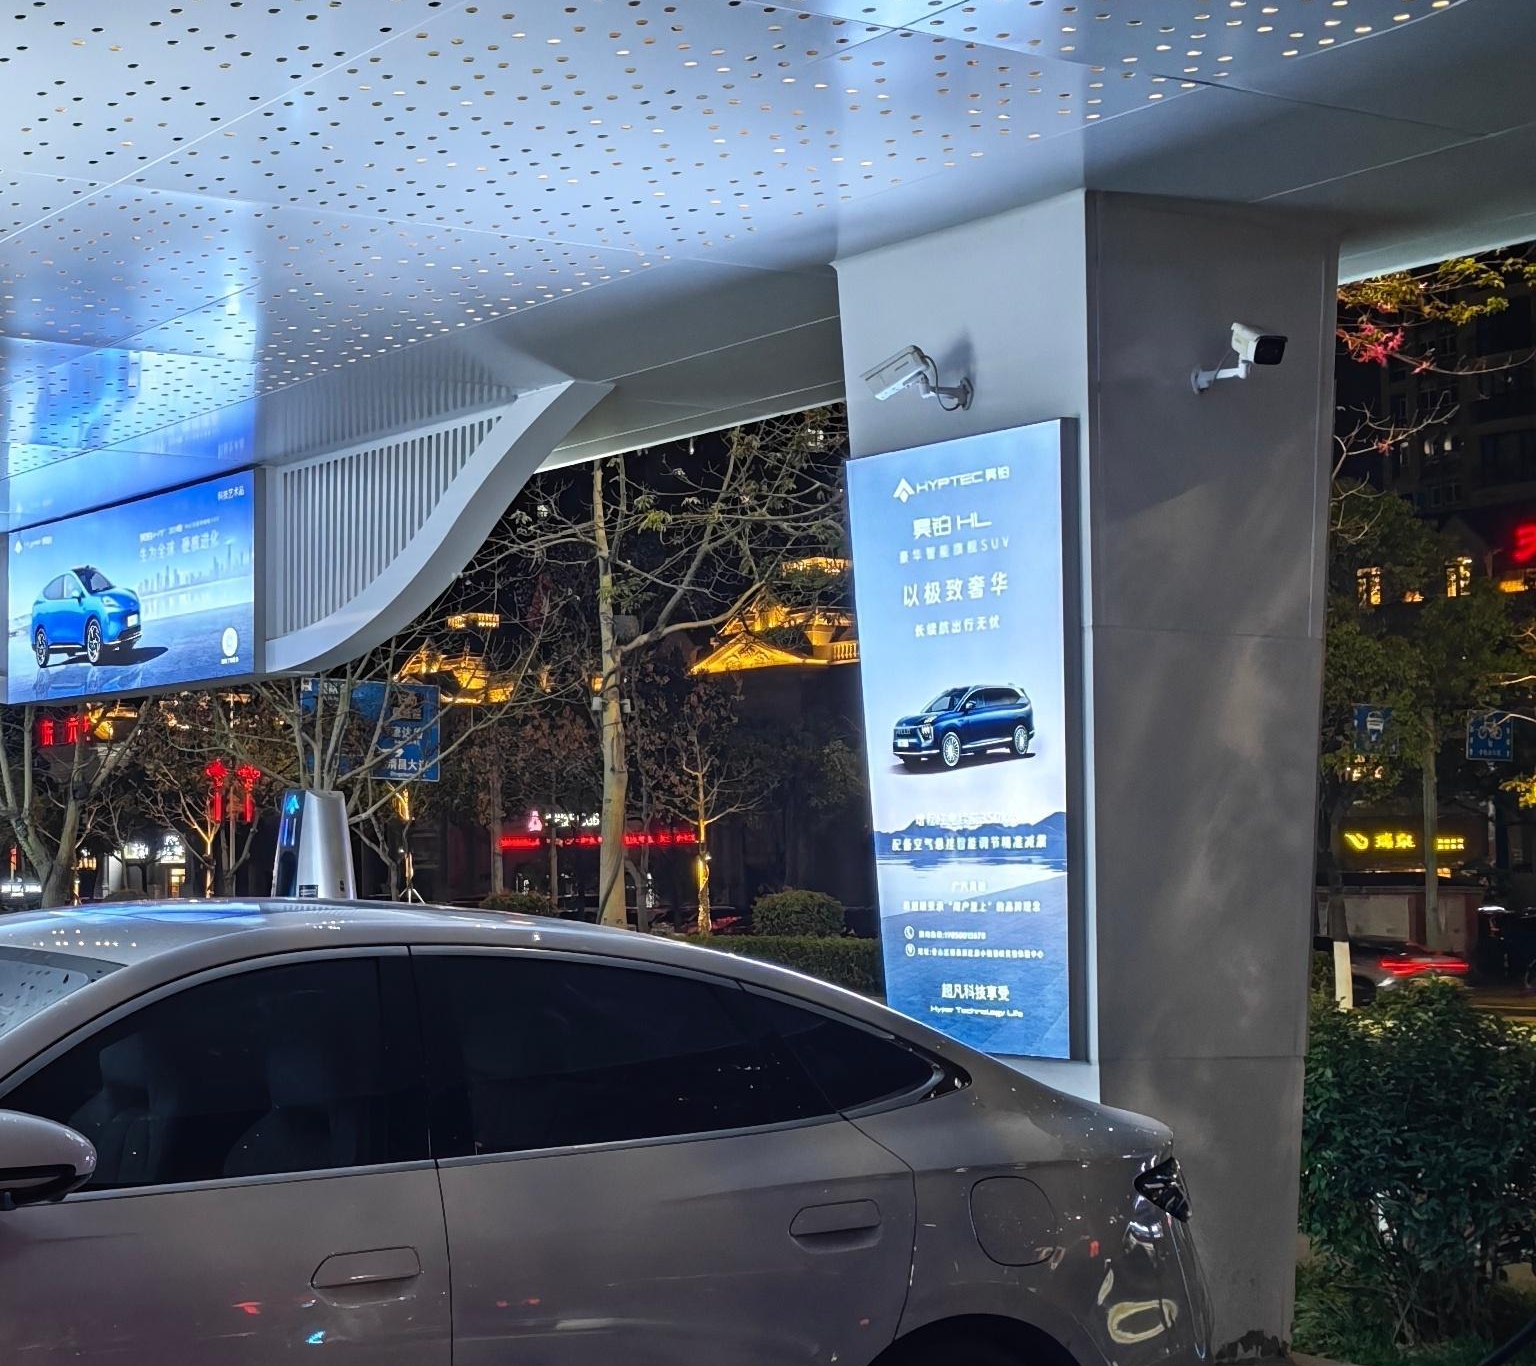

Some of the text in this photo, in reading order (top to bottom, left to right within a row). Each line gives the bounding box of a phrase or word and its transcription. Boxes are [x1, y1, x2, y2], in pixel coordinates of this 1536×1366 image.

[915, 470, 984, 494] HYPTEC
[913, 511, 993, 539] 昊铂 HL
[903, 571, 1009, 608] 以极致奢华
[914, 614, 1001, 638] 长续航出行无忧
[941, 982, 1011, 1002] 超凡科技享受
[930, 1005, 954, 1015] Hyper
